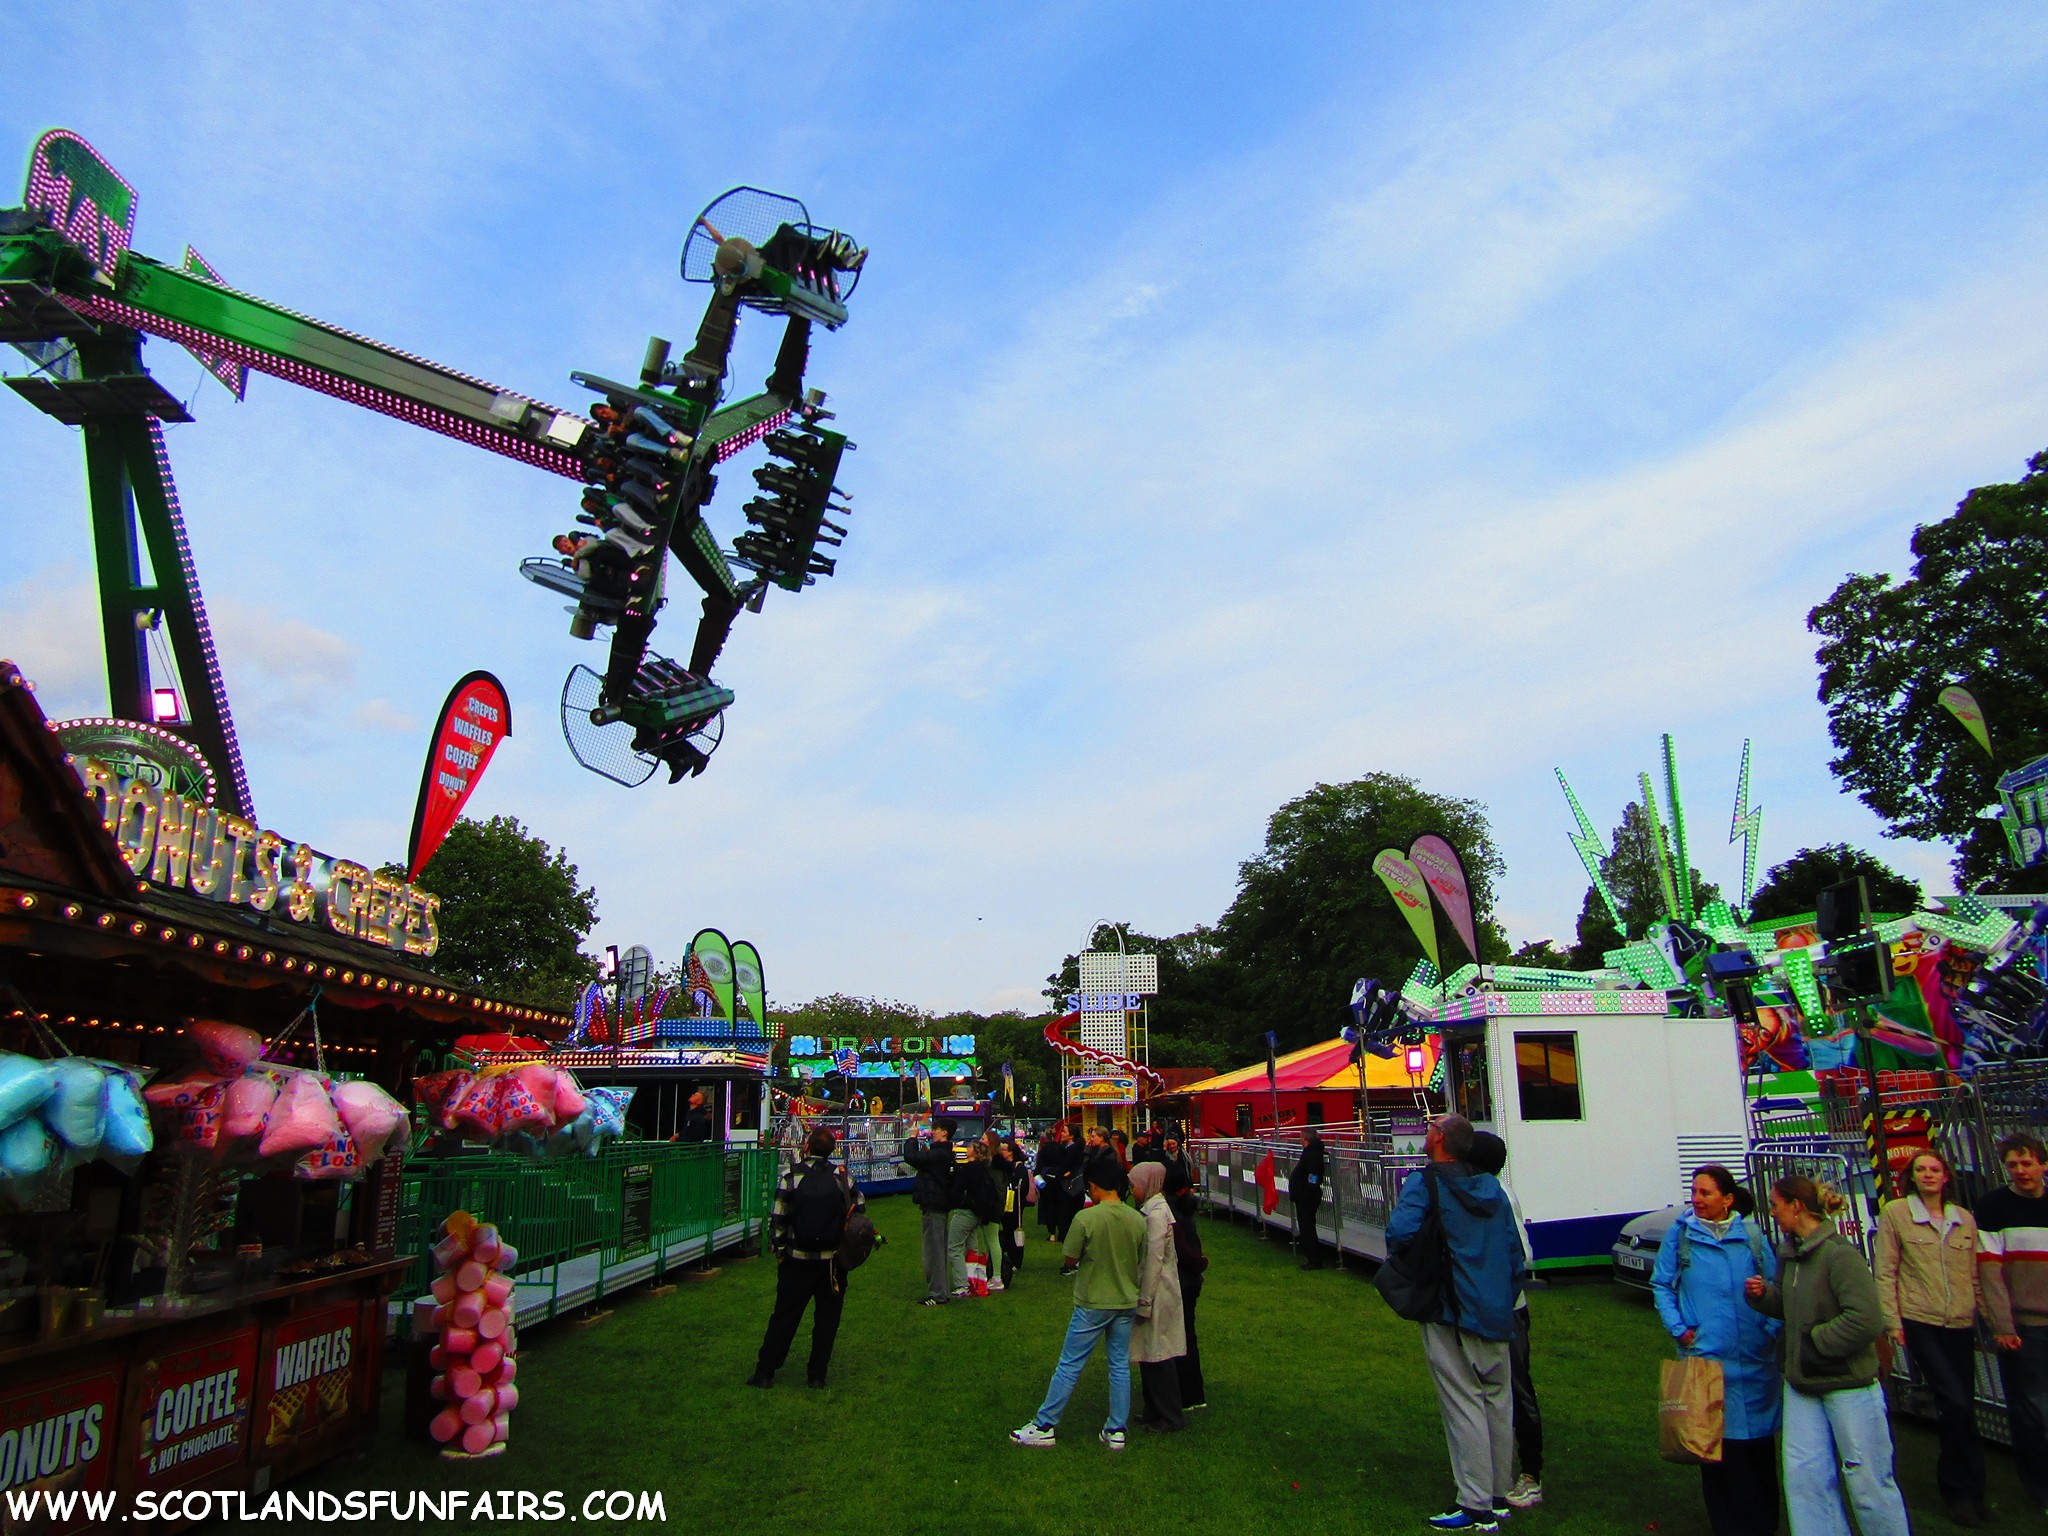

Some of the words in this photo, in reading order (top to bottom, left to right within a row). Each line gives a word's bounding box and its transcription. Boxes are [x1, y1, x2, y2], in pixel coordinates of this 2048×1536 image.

[468, 697, 498, 722] CREPES
[453, 716, 493, 746] WAFFLES
[74, 755, 281, 911] DONUTS
[289, 843, 317, 923] &
[328, 858, 441, 957] CREPES
[1066, 993, 1141, 1012] SLIDE
[816, 1036, 949, 1054] DRAGON
[1257, 1108, 1297, 1124] TAYORS
[310, 1153, 359, 1168] FLOSS
[1886, 1145, 1920, 1159] NOTIC
[275, 1326, 352, 1391] WAFFLES
[155, 1367, 239, 1442] COFFEE
[149, 1456, 157, 1475] &
[158, 1448, 179, 1470] HOT
[180, 1423, 234, 1463] CHOCOLATE
